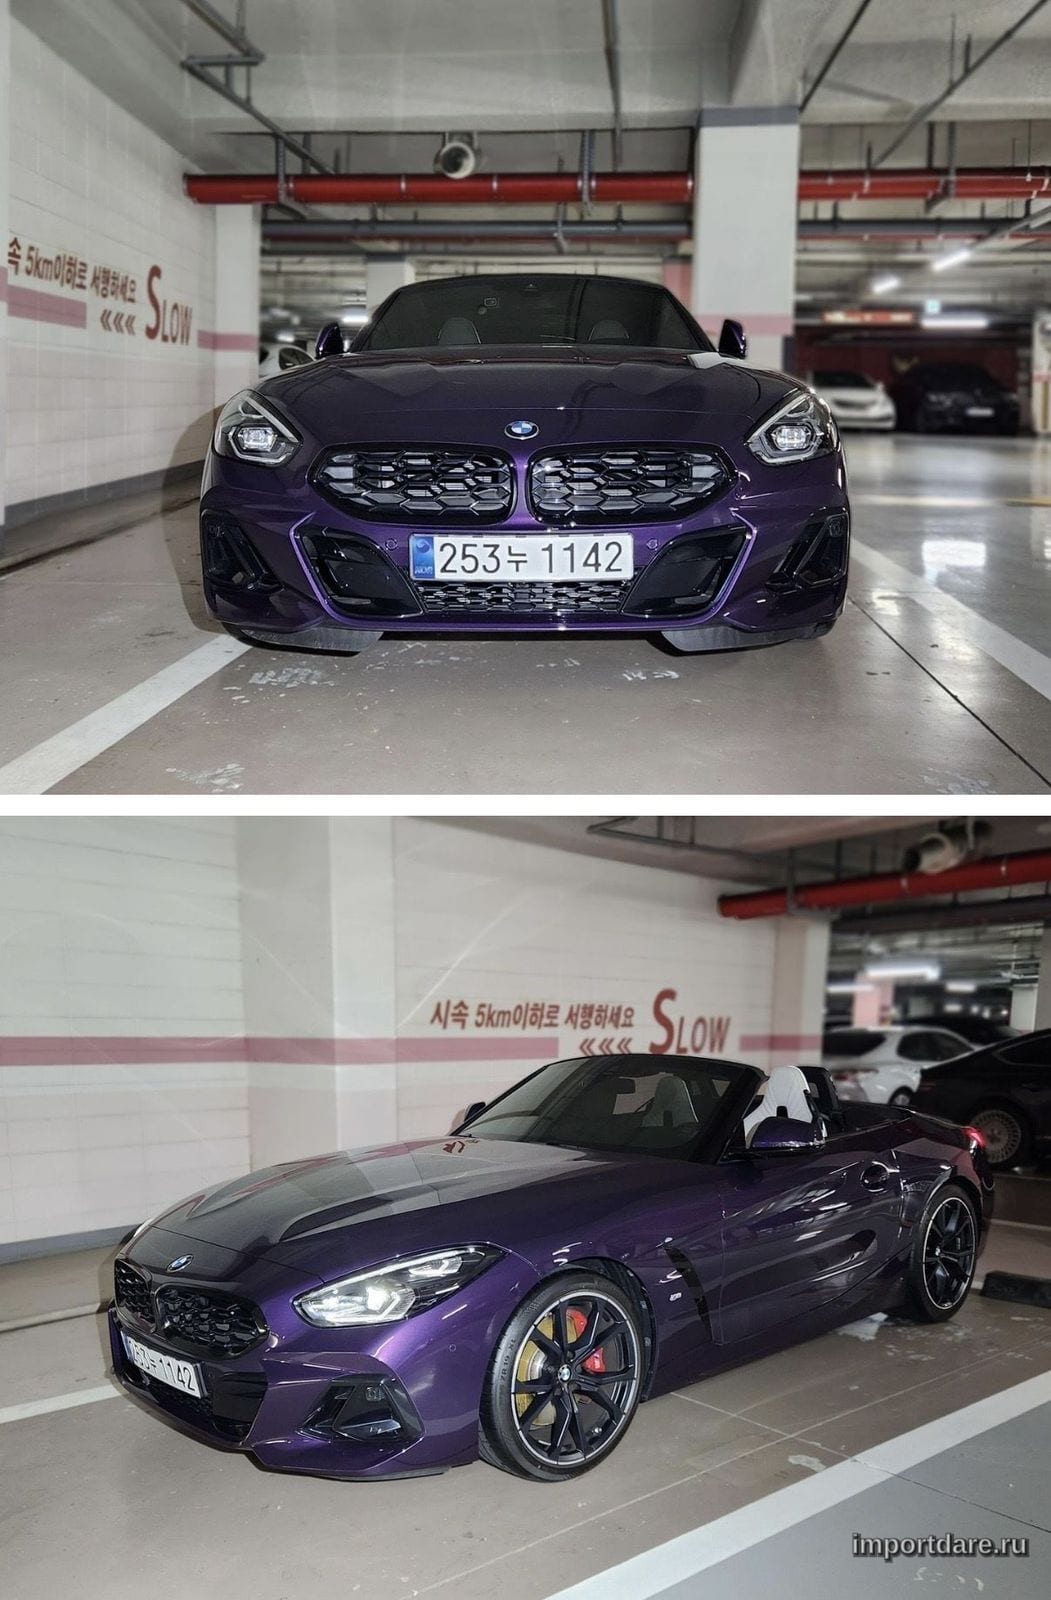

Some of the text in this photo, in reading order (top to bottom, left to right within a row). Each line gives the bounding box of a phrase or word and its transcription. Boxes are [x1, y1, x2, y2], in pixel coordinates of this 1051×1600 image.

[25, 246, 88, 290] 5km이하로
[90, 265, 137, 304] 서행하세요
[145, 264, 193, 346] SLOW
[439, 541, 623, 573] 253누 1142
[430, 999, 635, 1030] 시속 5km이하로 서행하세요
[649, 988, 731, 1055] SLOW
[159, 1357, 195, 1392] 1142
